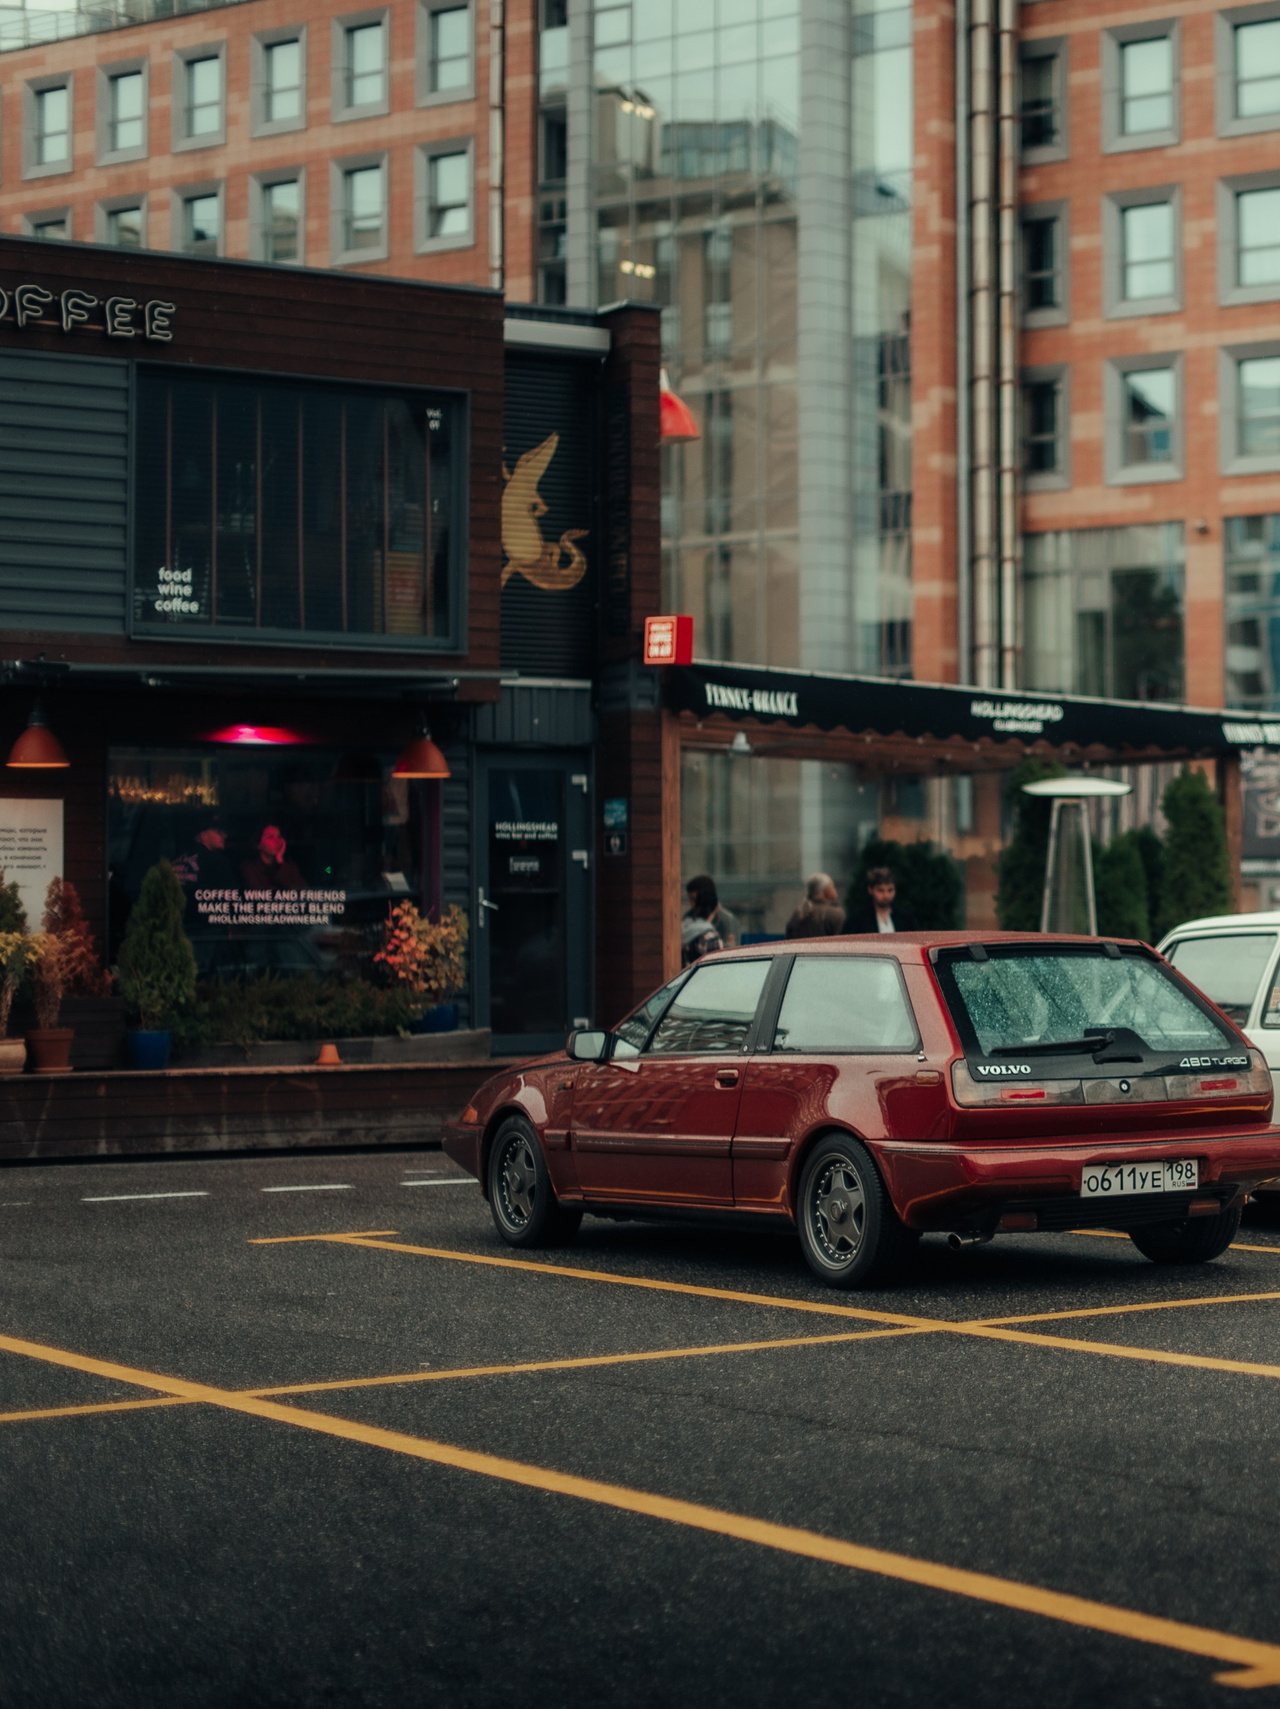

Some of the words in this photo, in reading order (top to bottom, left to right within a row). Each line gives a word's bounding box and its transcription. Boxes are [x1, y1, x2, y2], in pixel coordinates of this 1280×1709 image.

[158, 566, 192, 583] food
[157, 581, 193, 597] wine
[154, 597, 199, 613] coffee
[970, 700, 1064, 722] HOLLINGSHEAD
[495, 821, 558, 832] HOLLINGSHEAD
[195, 889, 242, 901] COFFEE,
[244, 889, 273, 901] WINE
[274, 889, 298, 901] AND
[300, 889, 346, 901] FRIENDS
[198, 902, 230, 914] MAKE
[232, 902, 254, 913] THE
[256, 902, 305, 914] PERFECT
[308, 902, 345, 914] BLEND
[208, 914, 329, 924] #HOLLINGSHEADWINEBAR
[1180, 1057, 1211, 1068] 480
[1211, 1056, 1248, 1066] TURBO
[976, 1064, 1032, 1076] VOLVO
[1166, 1162, 1193, 1181] 198
[1172, 1180, 1186, 1188] RUS
